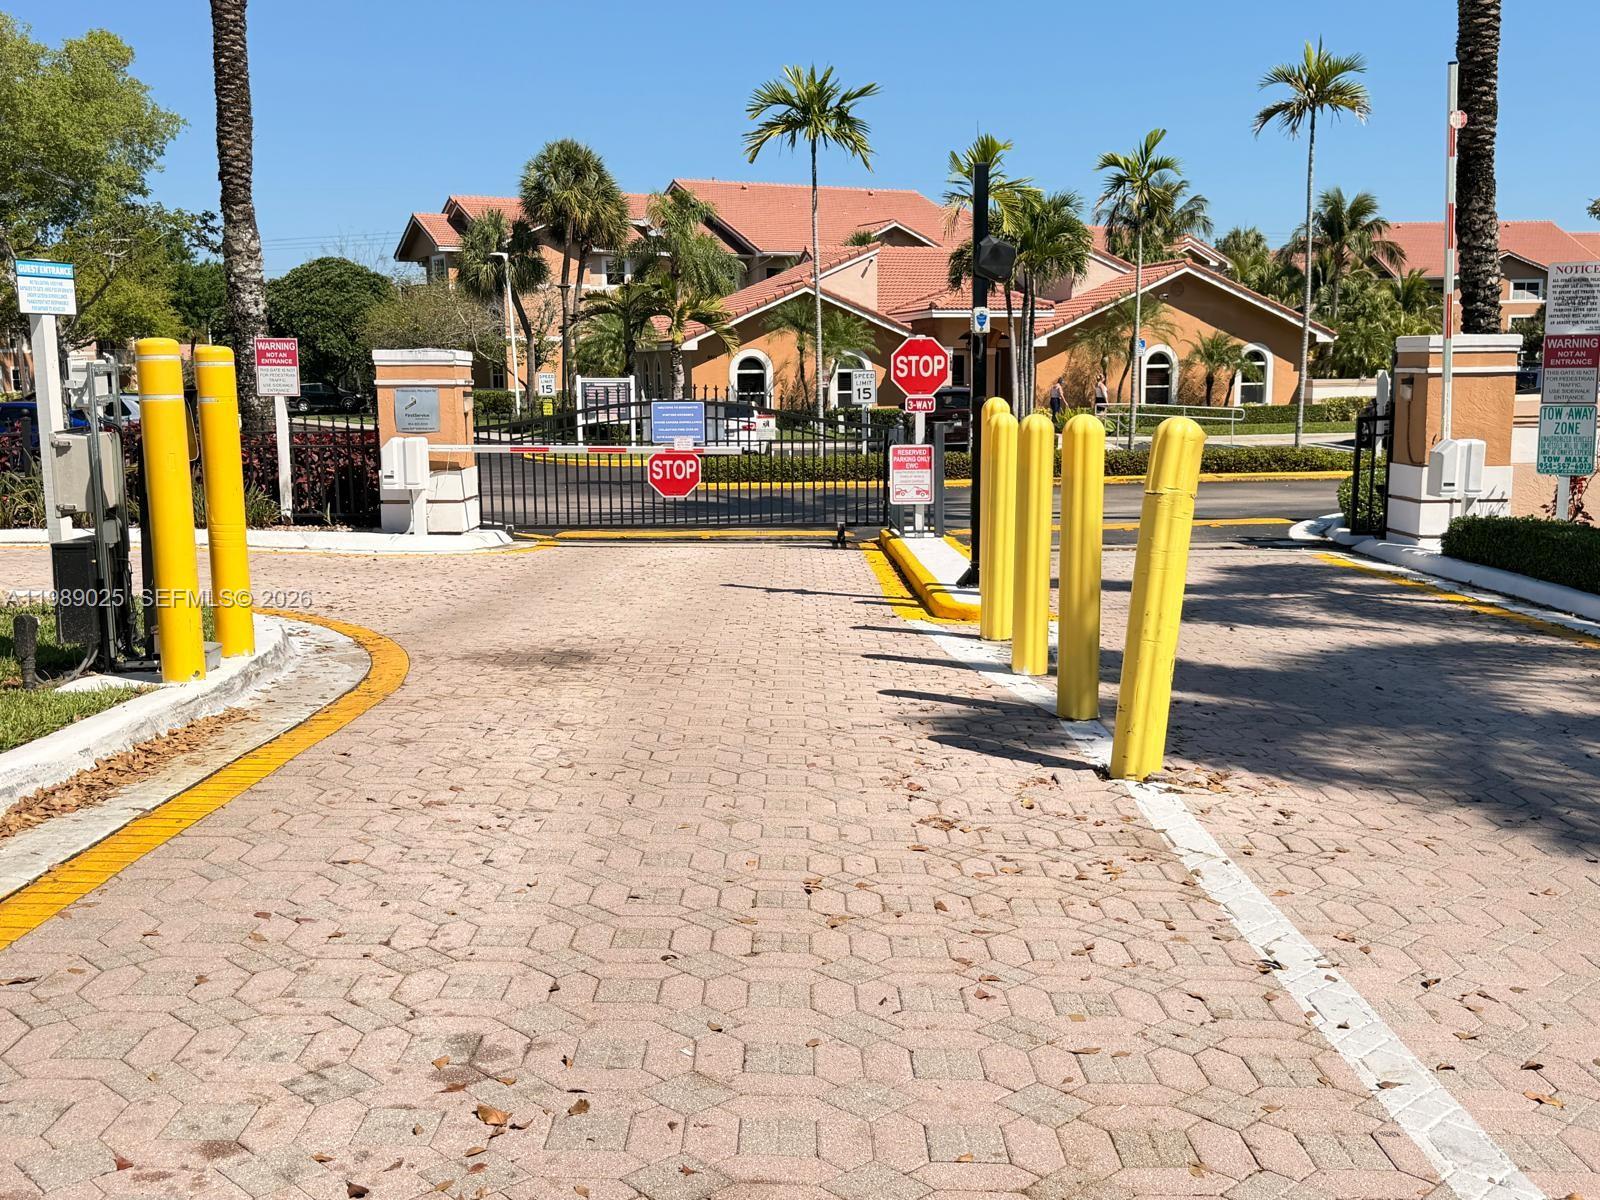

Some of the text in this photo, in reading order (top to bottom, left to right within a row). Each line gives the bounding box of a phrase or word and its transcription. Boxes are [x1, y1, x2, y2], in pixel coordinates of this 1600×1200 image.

[17, 264, 72, 276] GUEST ENTRANCE
[1556, 265, 1600, 274] NOTICE
[257, 342, 296, 350] WARNING
[1547, 338, 1598, 348] WARNING
[896, 355, 946, 378] STOP
[542, 384, 552, 394] 15
[857, 388, 872, 400] 15
[908, 400, 932, 410] 3-WAY
[1543, 408, 1594, 420] TOW AWAY
[1554, 422, 1580, 434] ZONE
[652, 460, 696, 480] STOP
